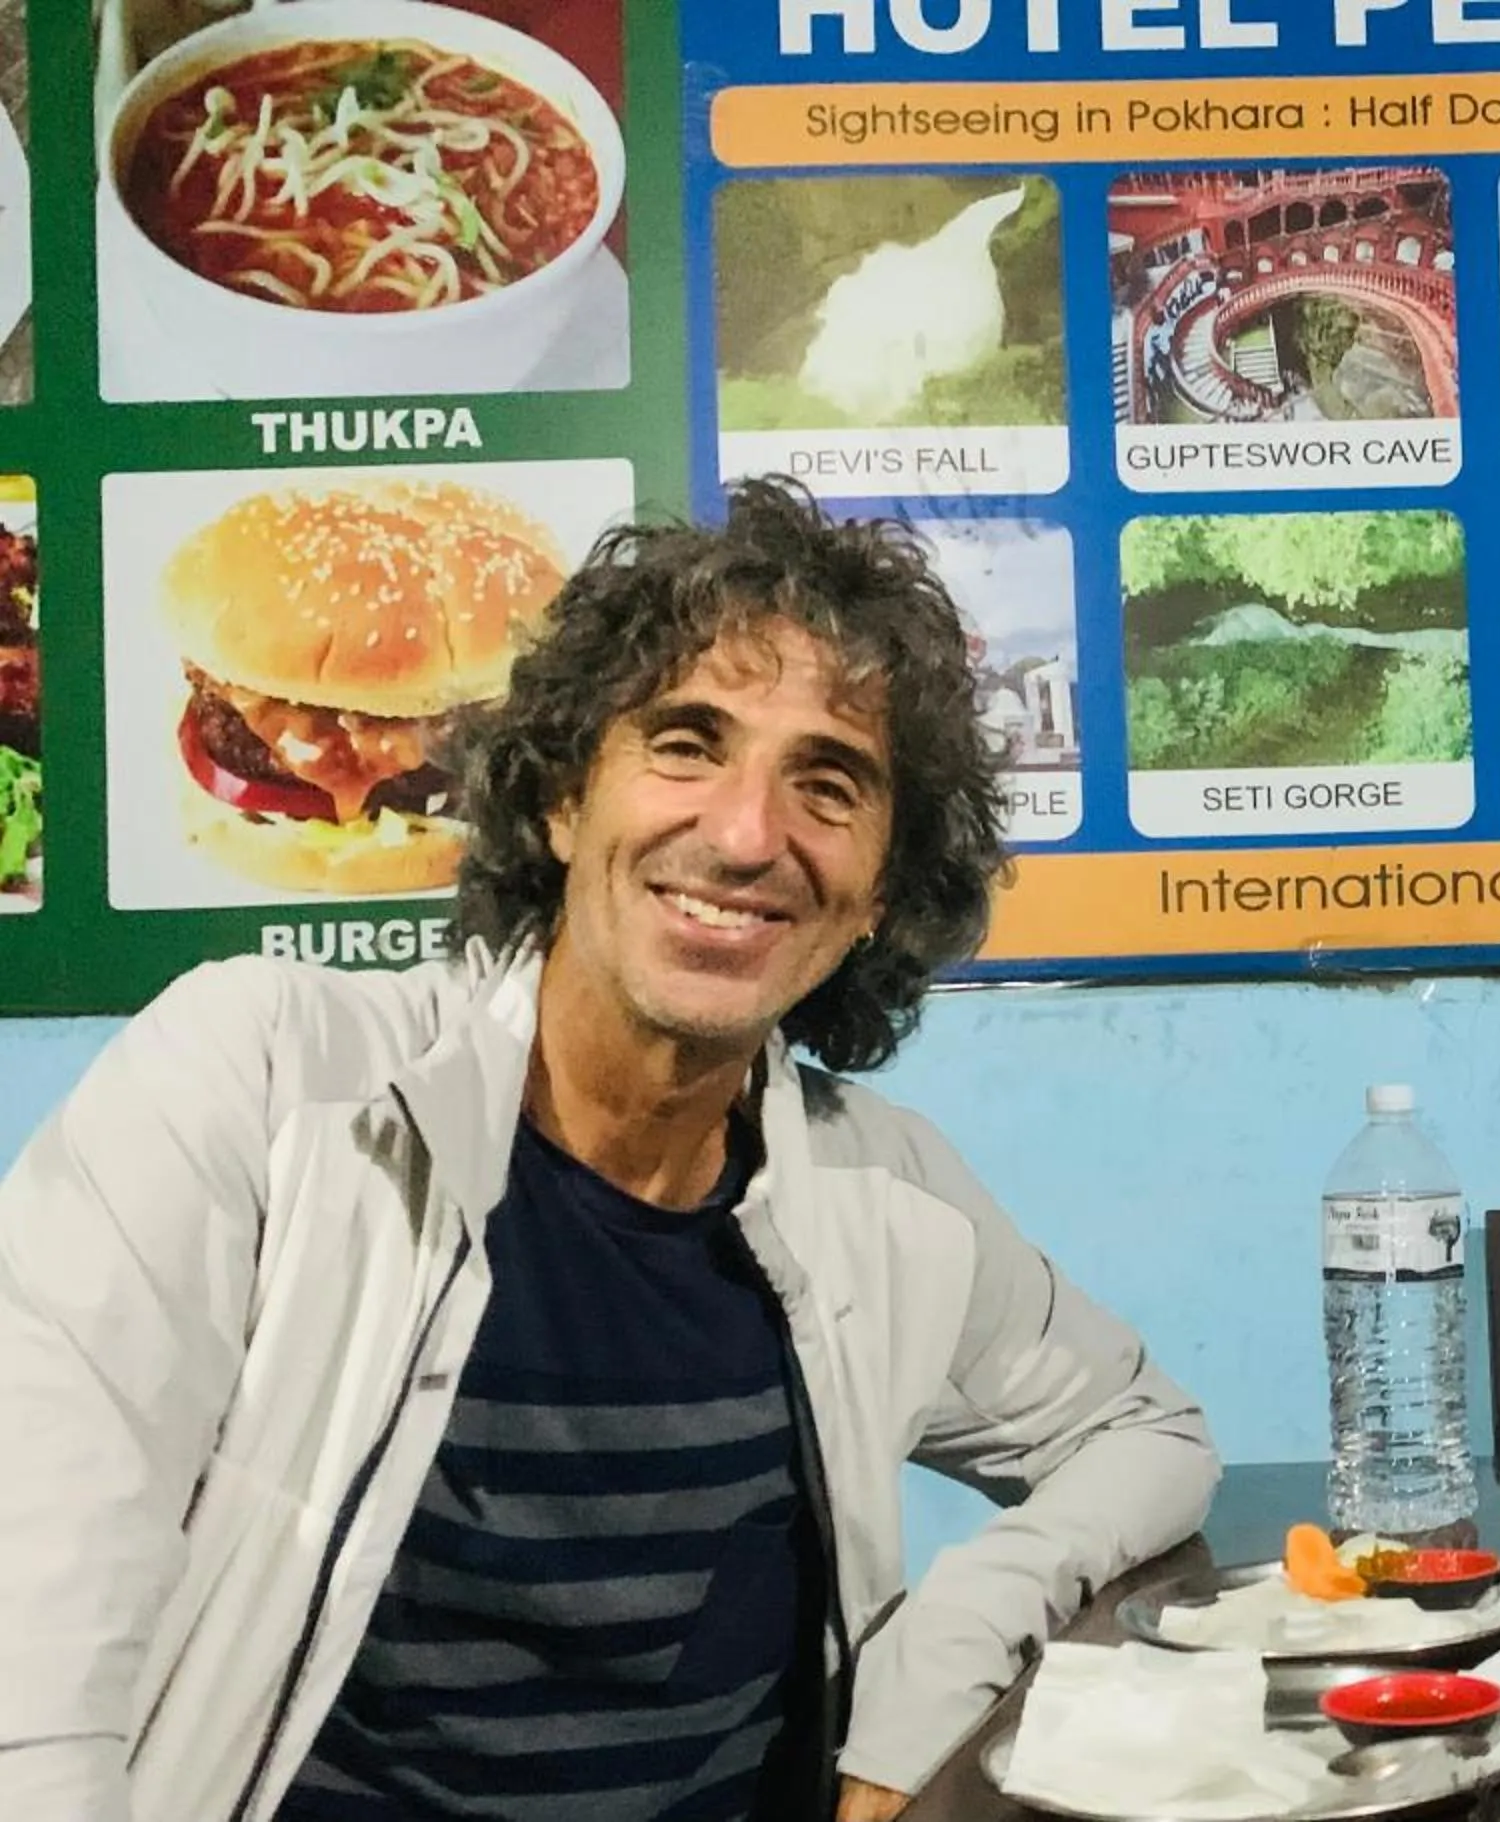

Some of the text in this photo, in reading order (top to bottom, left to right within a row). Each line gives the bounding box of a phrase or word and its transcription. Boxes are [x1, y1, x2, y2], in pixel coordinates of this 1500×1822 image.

[806, 102, 1059, 145] Sightseeing
[1077, 101, 1111, 133] in
[1128, 98, 1304, 132] Pokhara
[1349, 94, 1433, 128] Half
[251, 407, 483, 454] THUKPA
[788, 447, 997, 476] DEVI'S FALL
[1126, 438, 1451, 470] GUPTESWOR CAVE
[1203, 781, 1402, 811] SETI GORGE
[260, 918, 452, 964] BURGE
